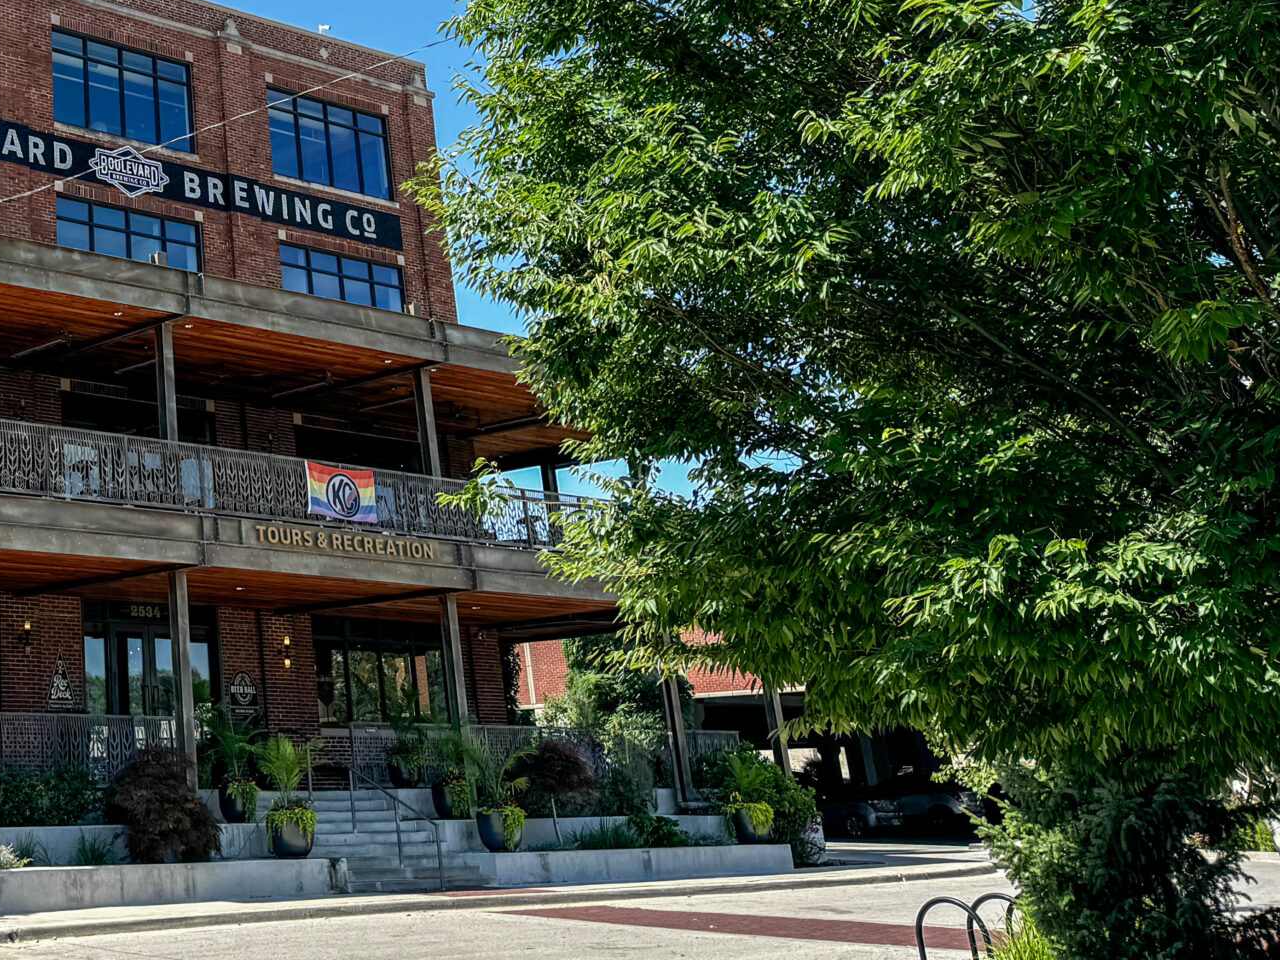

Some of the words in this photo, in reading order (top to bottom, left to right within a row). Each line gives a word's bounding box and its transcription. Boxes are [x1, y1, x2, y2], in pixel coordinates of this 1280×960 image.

[100, 155, 158, 186] BOULEVARD
[183, 170, 334, 230] BREWING
[331, 478, 358, 514] KC
[255, 525, 312, 547] TOURS
[317, 532, 328, 548] &
[332, 533, 435, 560] RECREATION
[130, 604, 161, 618] 2534
[50, 687, 72, 699] Deck
